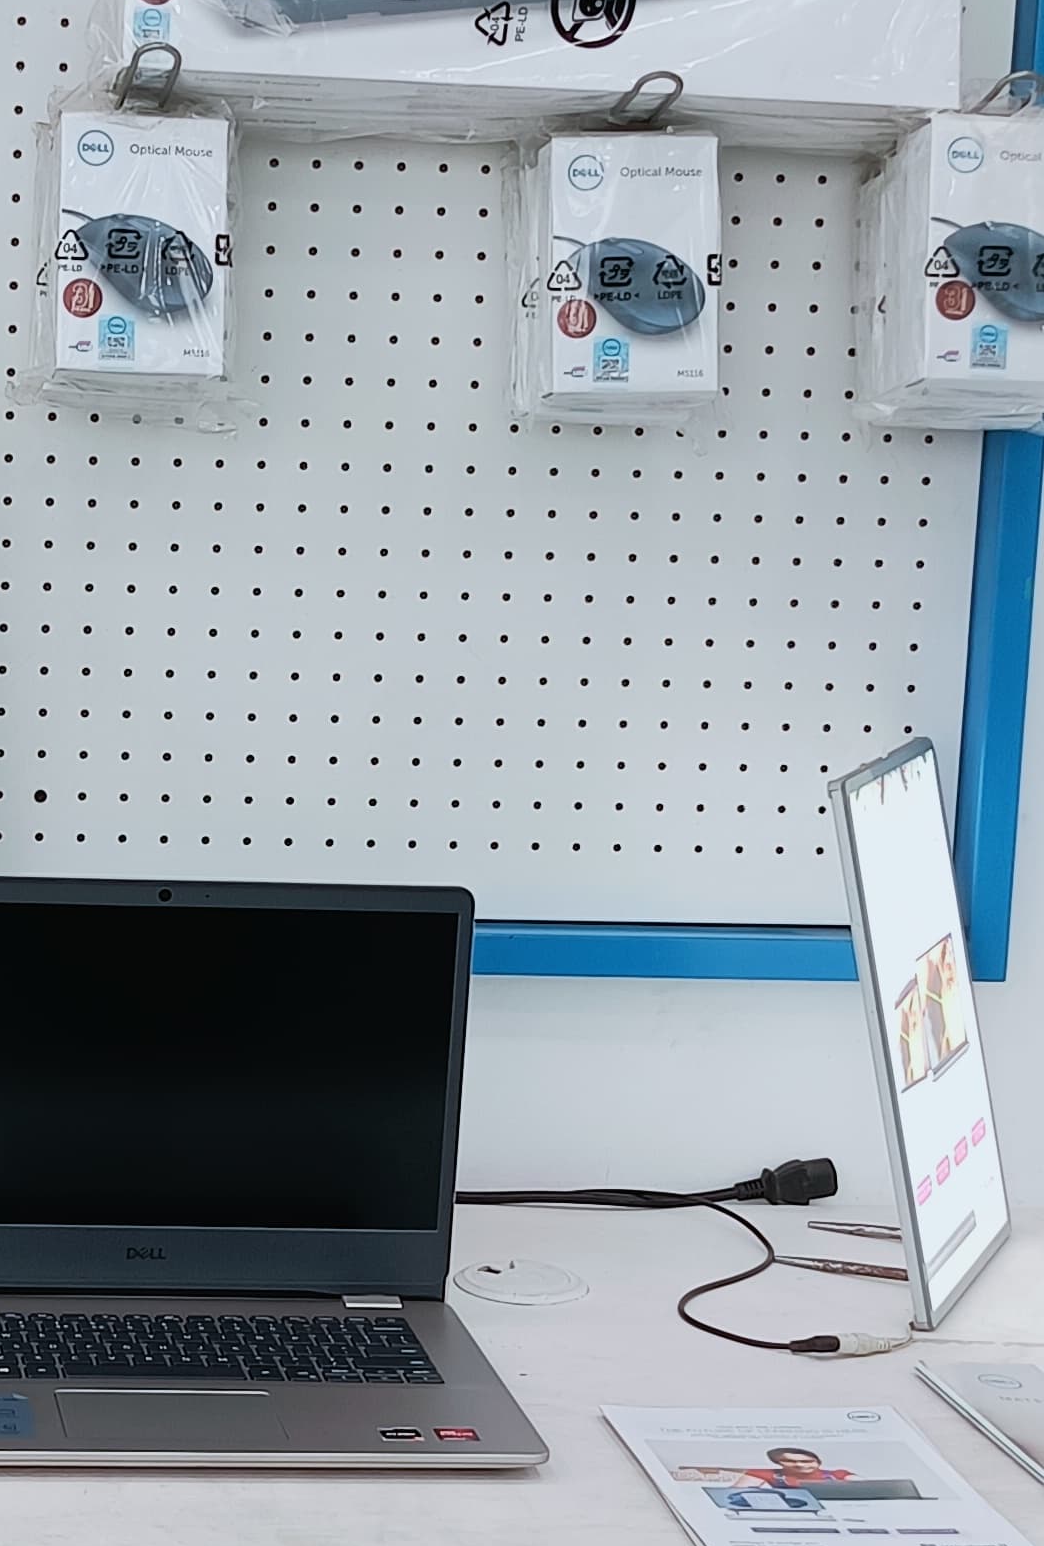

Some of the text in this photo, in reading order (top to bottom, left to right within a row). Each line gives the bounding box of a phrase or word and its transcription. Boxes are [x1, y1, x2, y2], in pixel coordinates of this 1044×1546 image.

[514, 5, 529, 43] PE-LD
[82, 143, 109, 153] DELL
[129, 143, 213, 157] Optical Mouse
[999, 150, 1042, 163] Optical
[620, 166, 703, 179] Optical Mouse
[63, 242, 78, 254] 04
[934, 259, 950, 271] 04
[556, 273, 571, 285] 04
[126, 1247, 166, 1260] DELL
